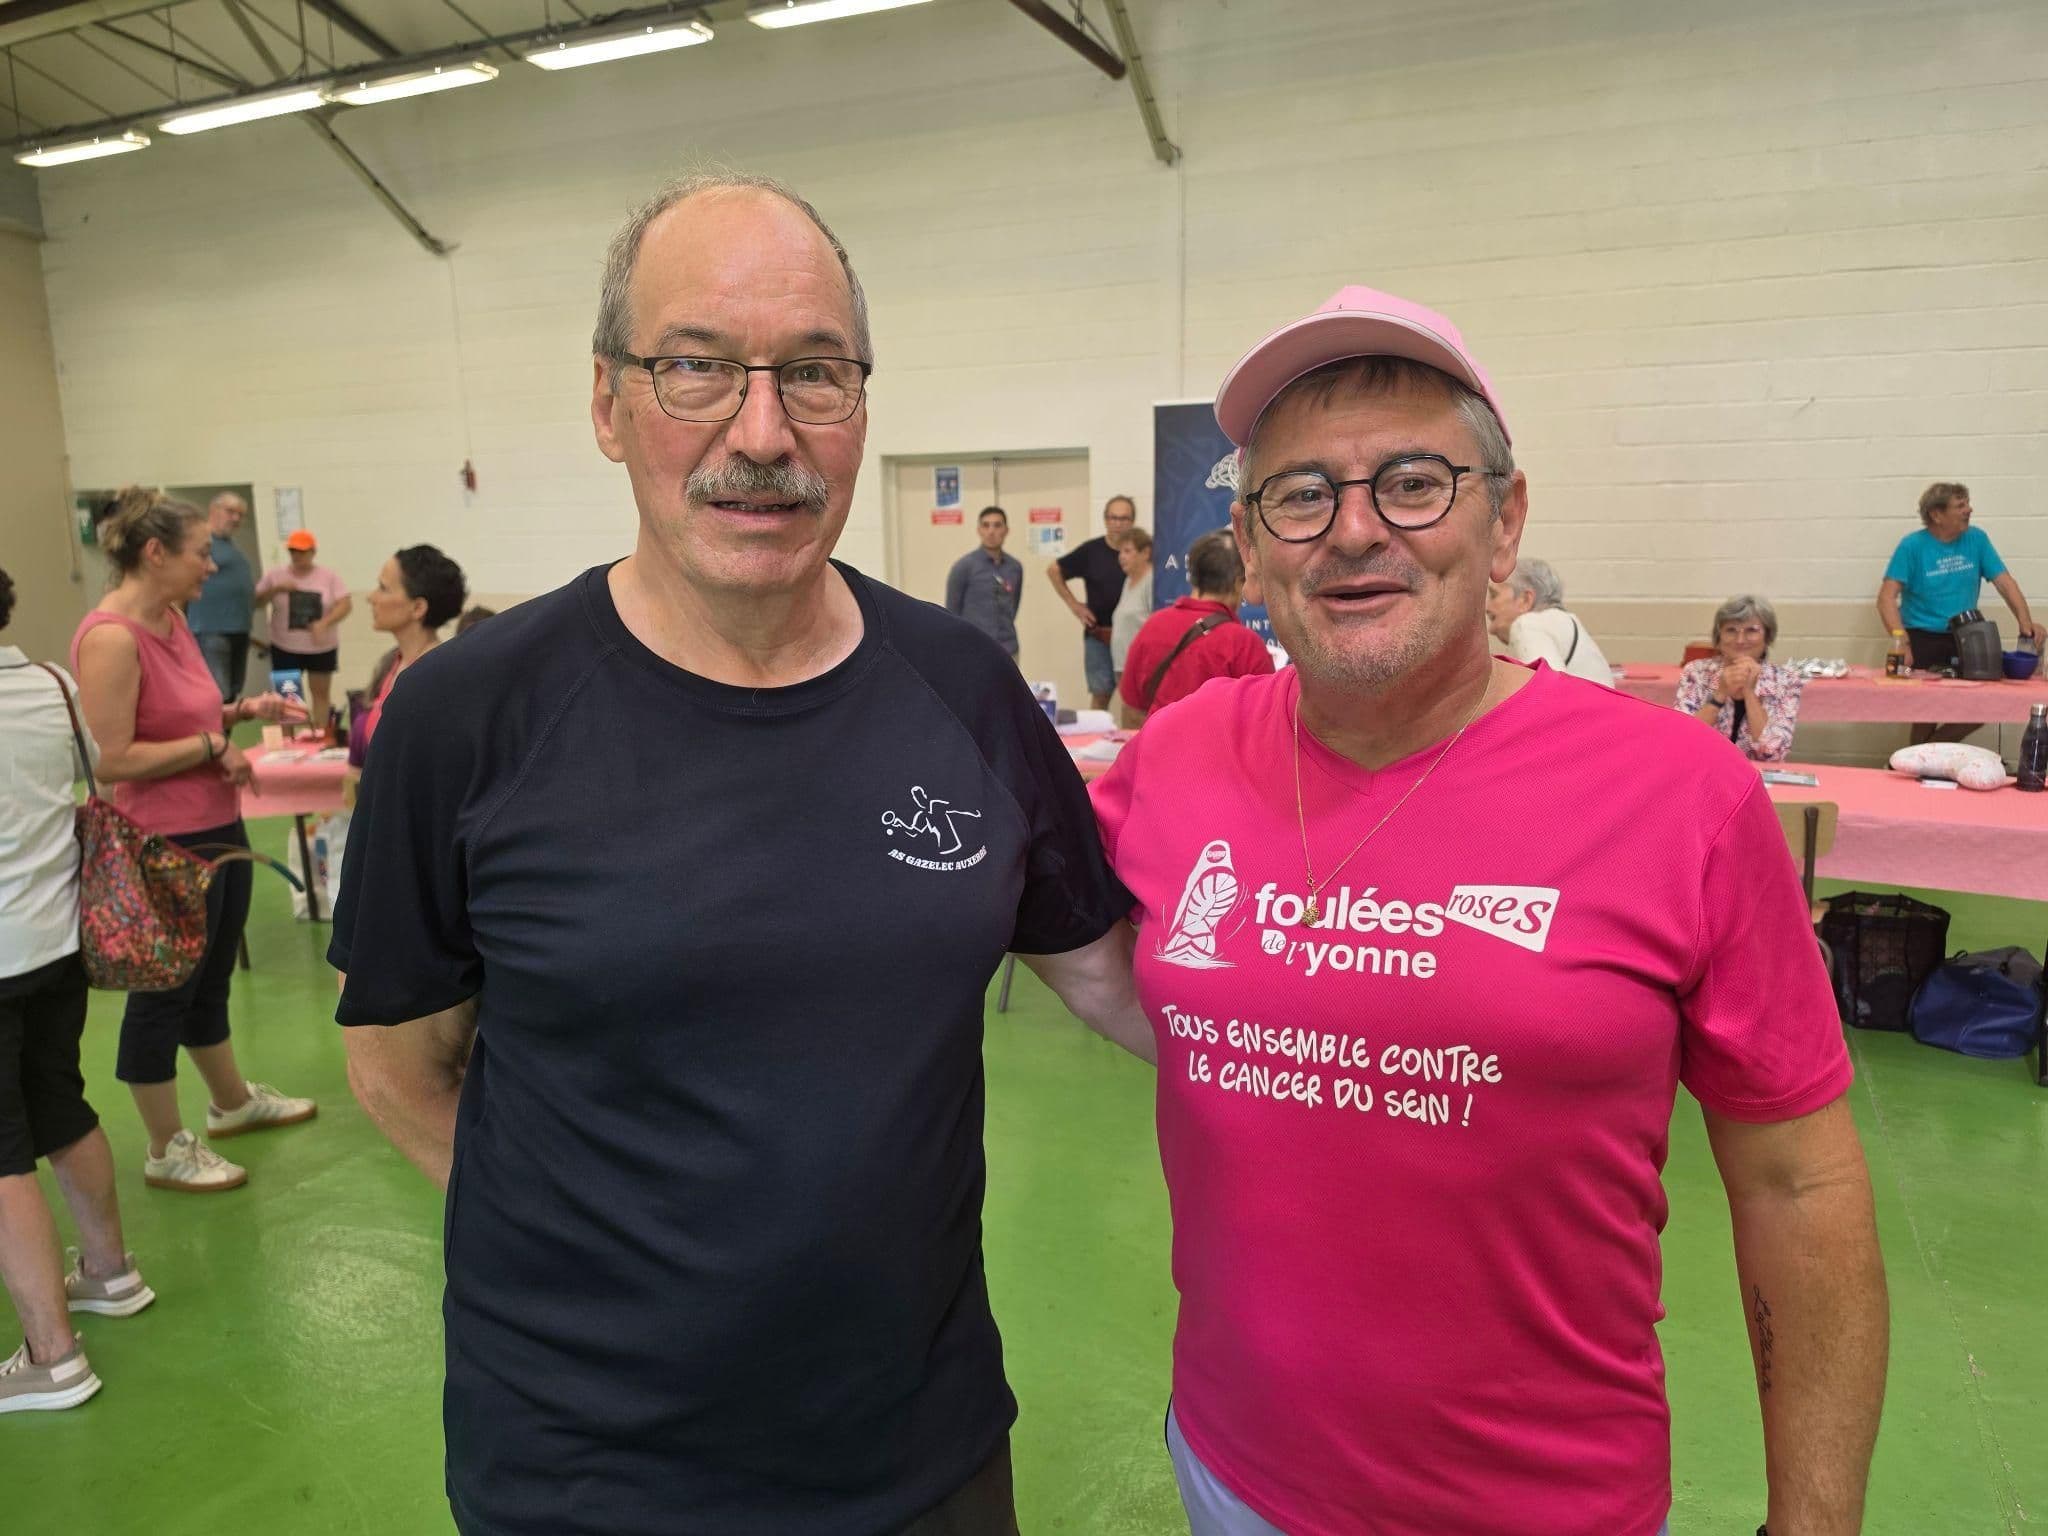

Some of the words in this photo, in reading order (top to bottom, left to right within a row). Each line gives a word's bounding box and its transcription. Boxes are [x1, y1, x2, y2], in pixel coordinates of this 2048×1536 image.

[888, 849, 906, 861] AS
[905, 855, 954, 871] GAZELEC
[1255, 882, 1445, 937] foulées
[1449, 894, 1551, 934] roses
[1262, 934, 1286, 951] de
[1161, 1004, 1219, 1044] TOUS
[1226, 1019, 1370, 1068] ENSEMBLE
[1380, 1044, 1502, 1087] CONTRE
[1188, 1050, 1212, 1083] LE
[1219, 1061, 1323, 1109] CANCER
[1333, 1078, 1373, 1112] DU
[1384, 1088, 1449, 1126] SEIN
